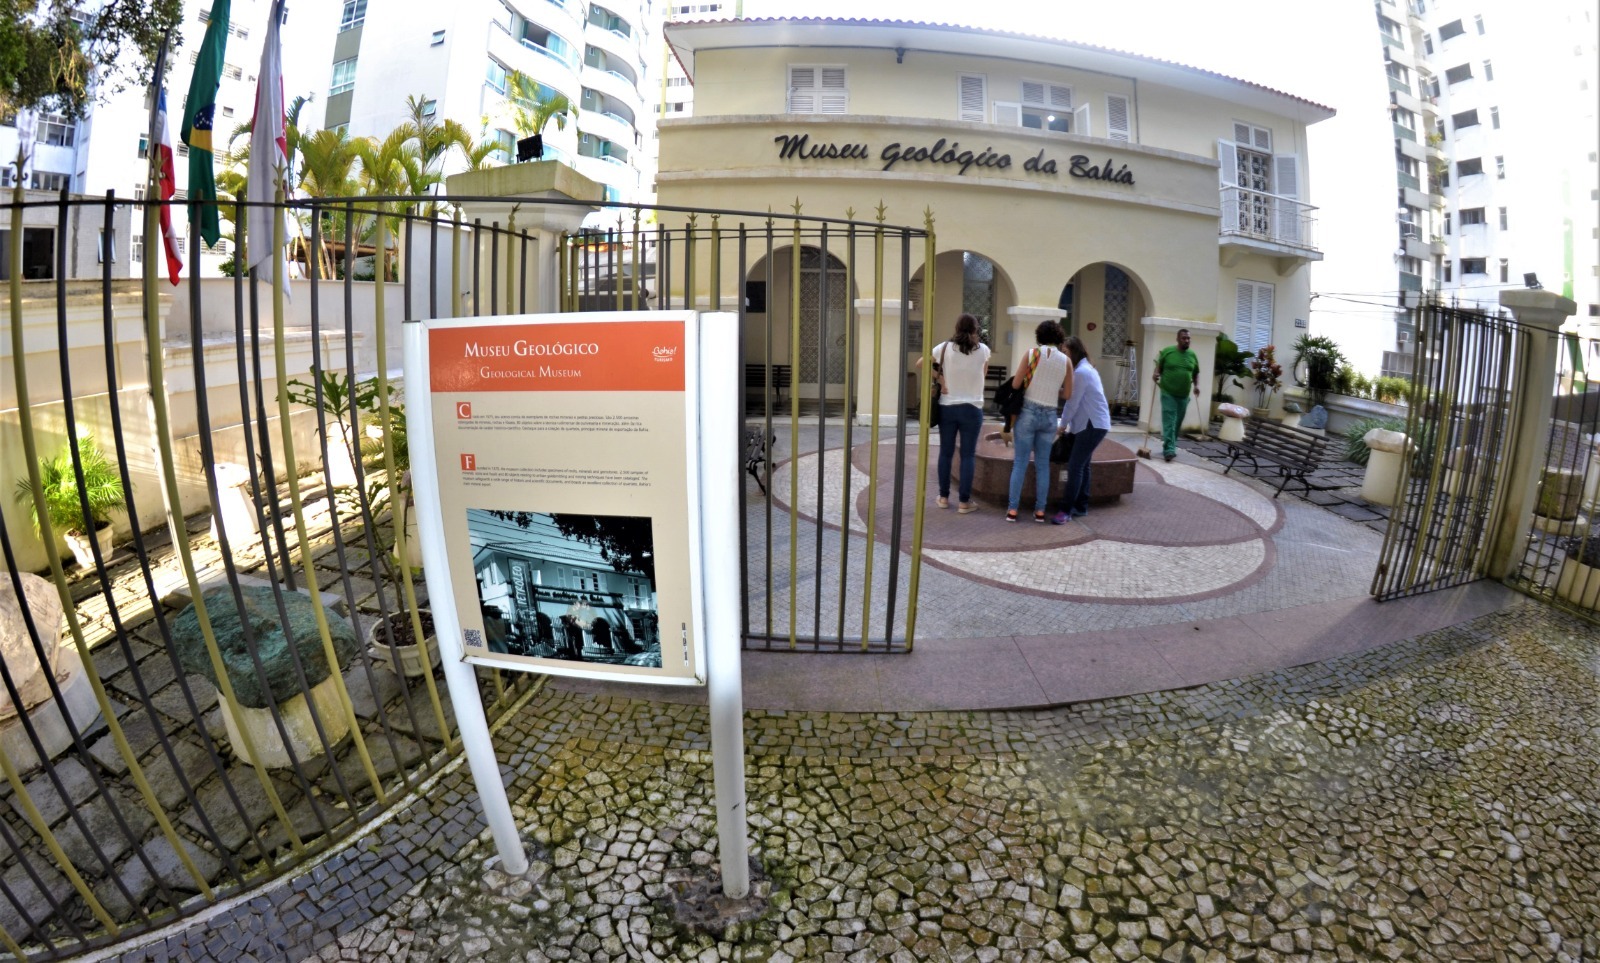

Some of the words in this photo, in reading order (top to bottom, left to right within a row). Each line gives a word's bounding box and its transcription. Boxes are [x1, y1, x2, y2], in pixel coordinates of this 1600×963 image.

[775, 134, 869, 160] Museu
[1024, 149, 1058, 174] da
[464, 342, 510, 358] MUSEU
[514, 340, 599, 357] GEOLÓGICO
[480, 366, 535, 379] GEOLOGICAL
[539, 365, 582, 378] MUSEUM
